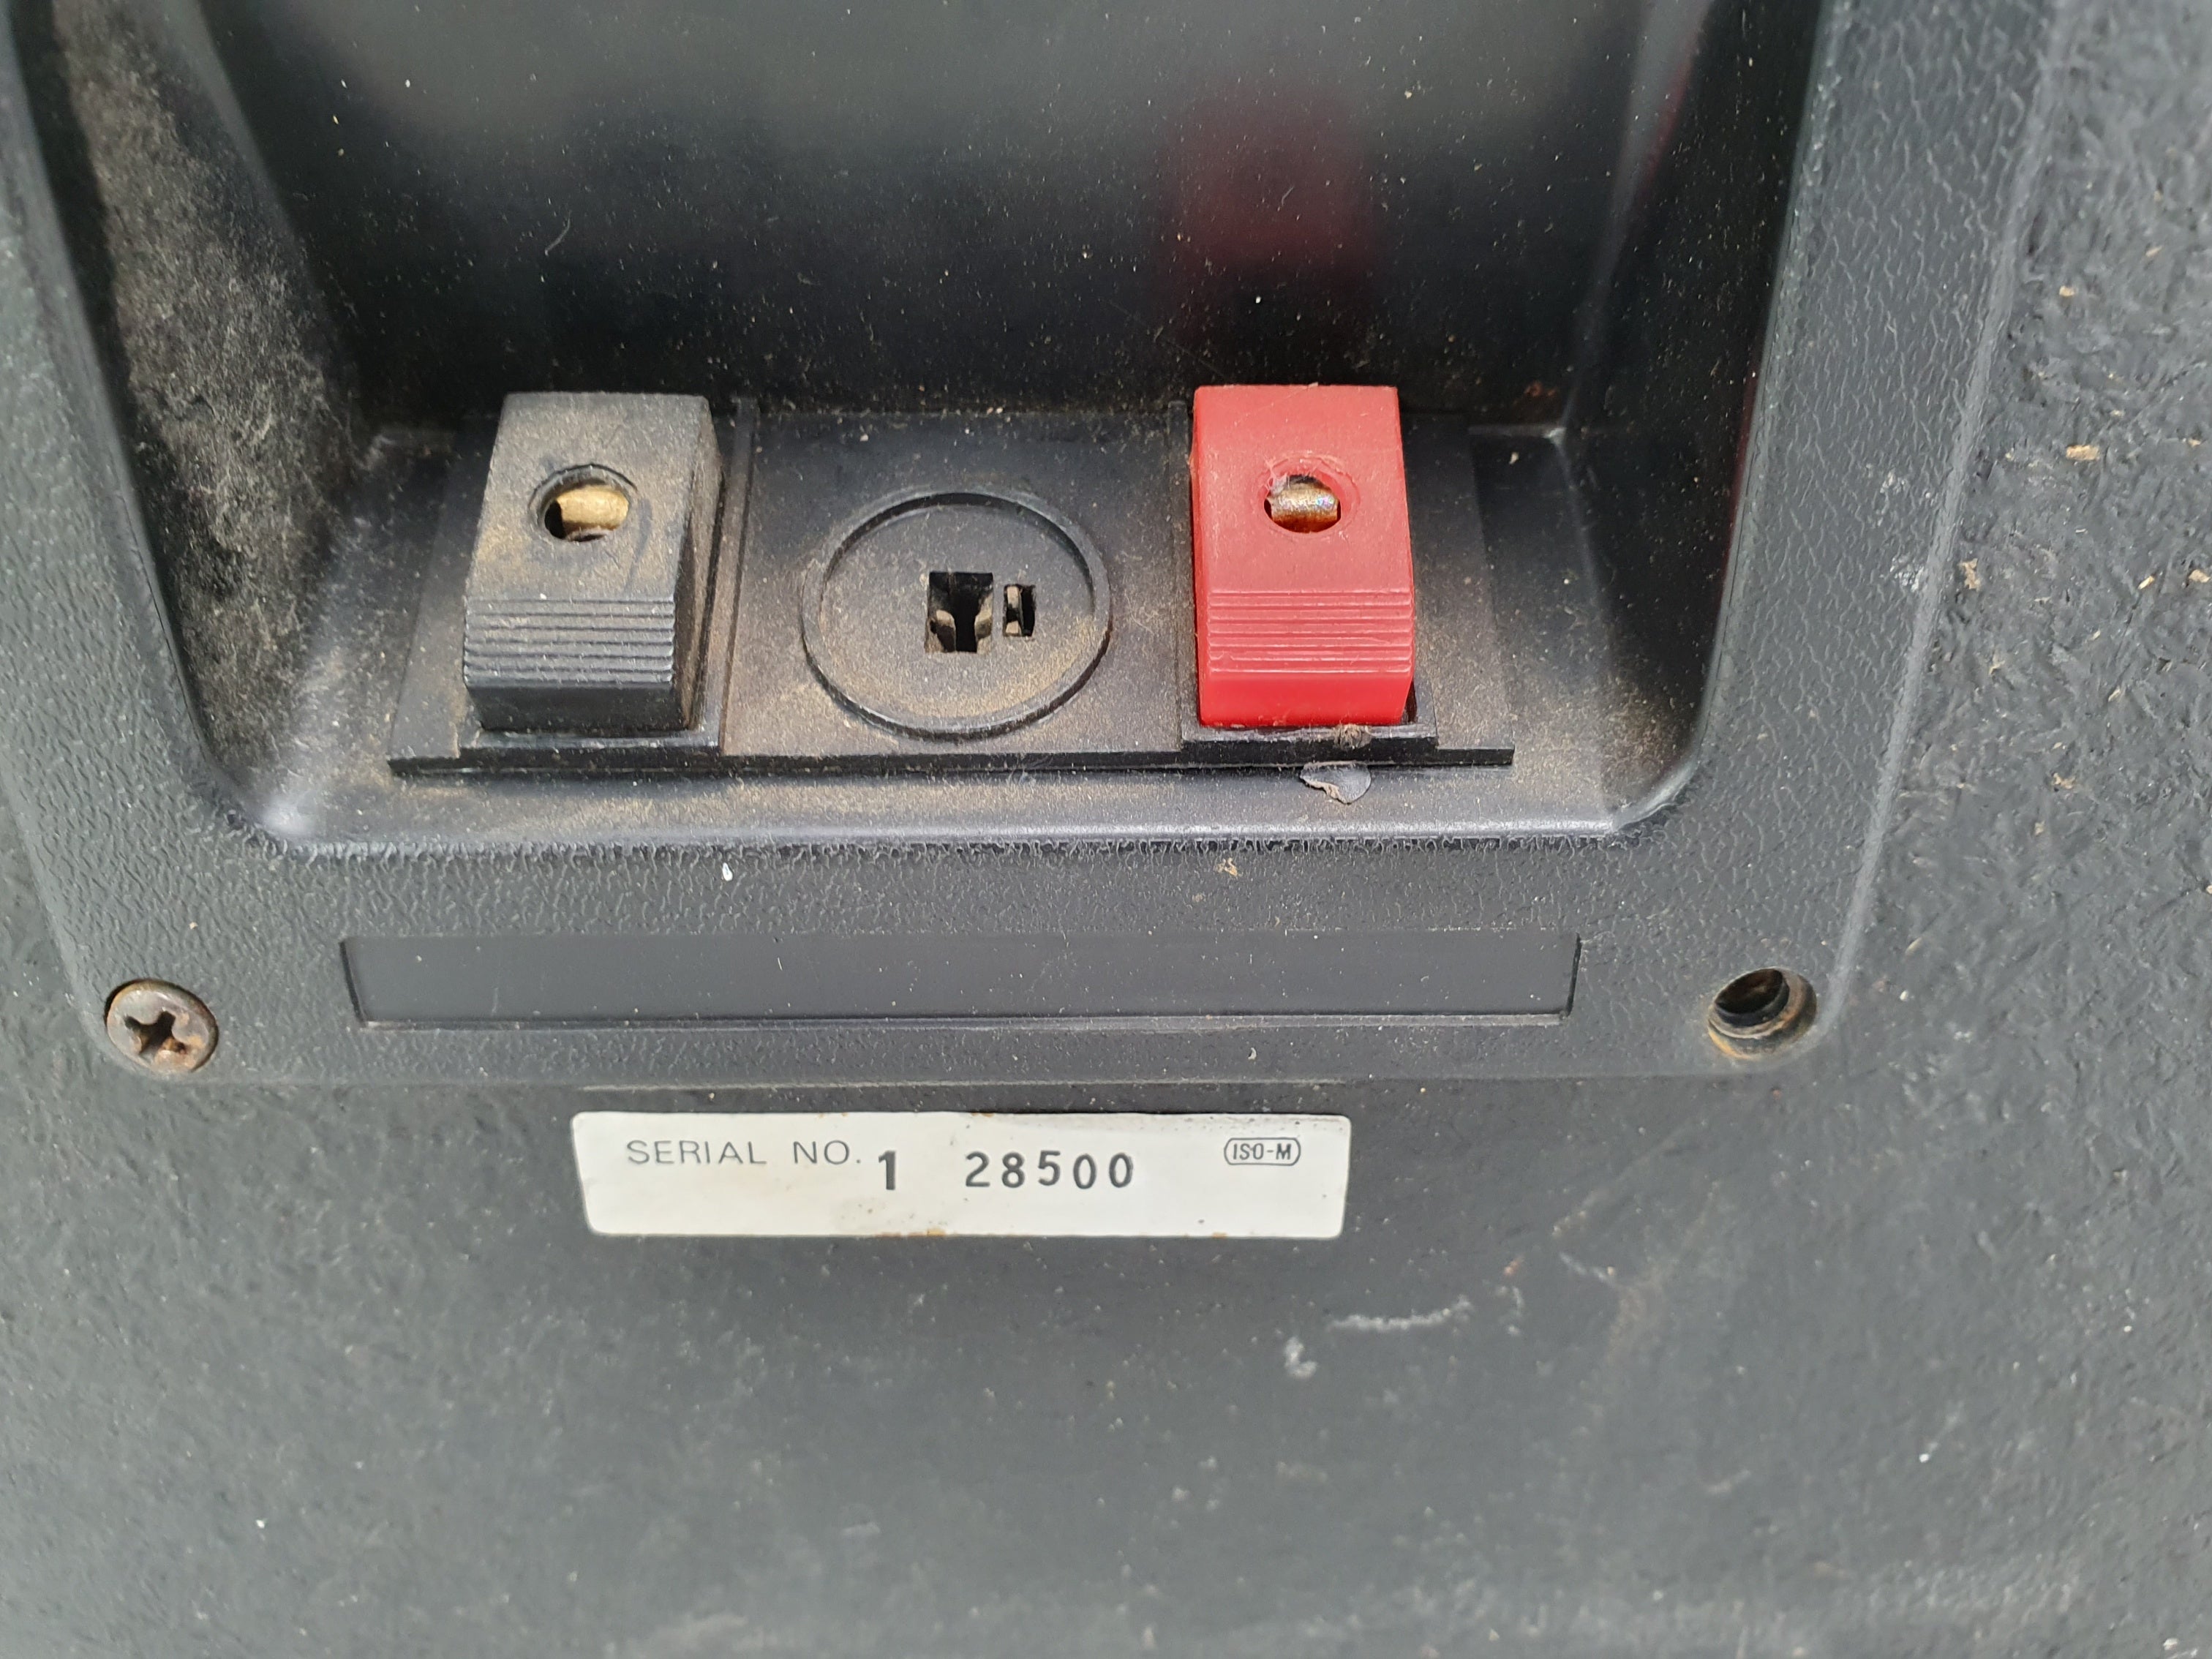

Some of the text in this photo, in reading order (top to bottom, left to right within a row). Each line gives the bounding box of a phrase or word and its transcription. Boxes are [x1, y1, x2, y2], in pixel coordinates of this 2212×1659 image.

[626, 1140, 1134, 1191] SERIAL NO. 1 28500
[1233, 1143, 1291, 1160] ISO-M
